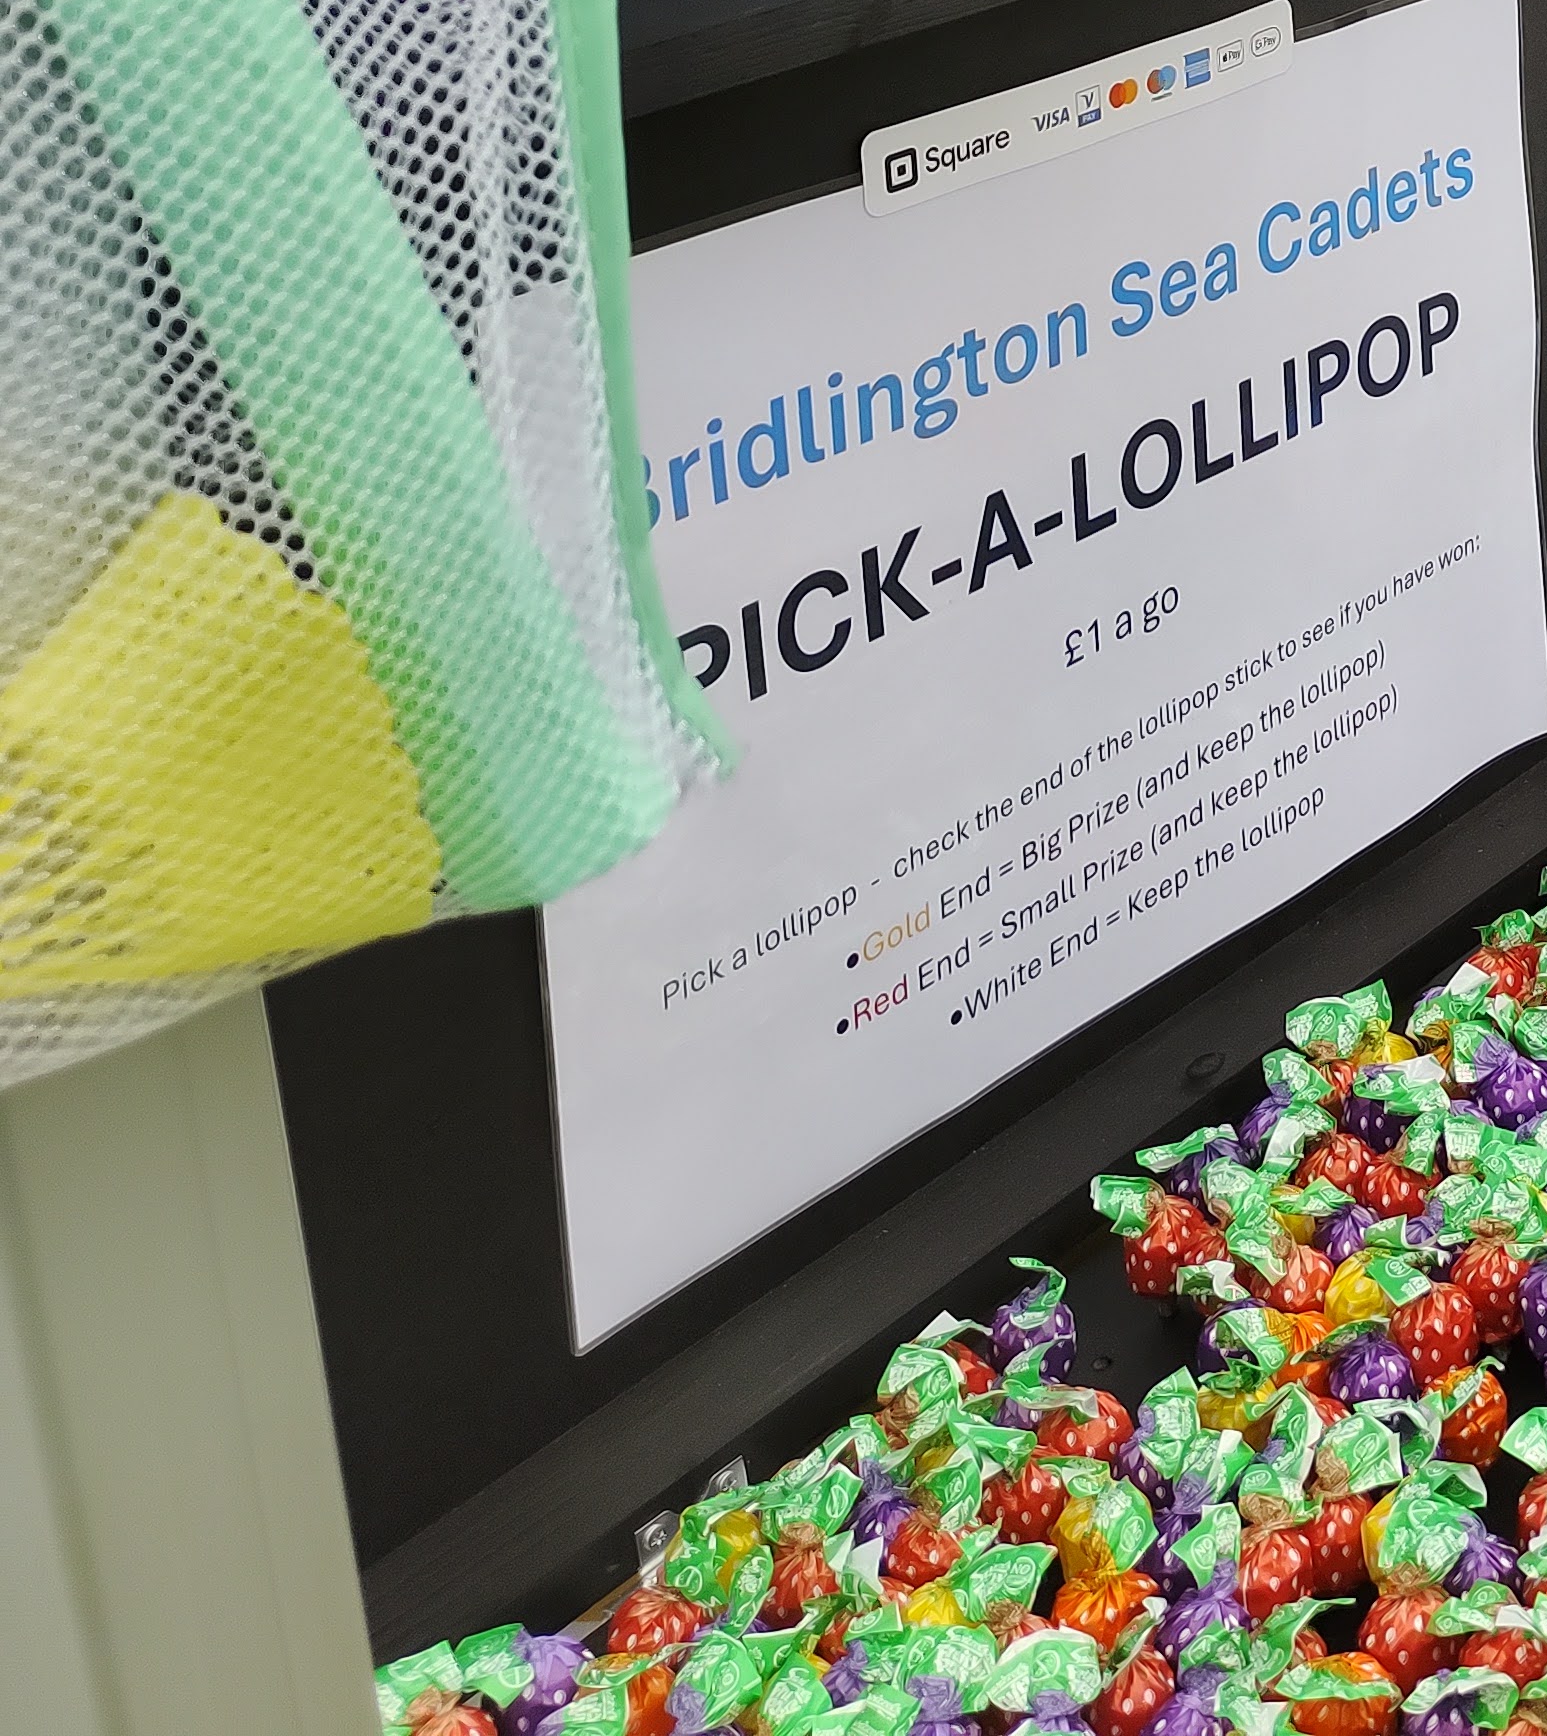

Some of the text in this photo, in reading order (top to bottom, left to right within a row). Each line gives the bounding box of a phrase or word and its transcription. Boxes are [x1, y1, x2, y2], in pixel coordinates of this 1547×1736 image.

[924, 126, 1011, 174] Square
[1031, 106, 1071, 134] VISA
[1108, 242, 1240, 340] Sea
[1256, 140, 1477, 277] Cadets
[676, 292, 1460, 704] PICK-A-LOLLIPOP
[1062, 583, 1181, 671] £1 a go
[662, 957, 726, 1011] Pick
[731, 946, 749, 971] a
[755, 884, 858, 957] lollipop
[893, 818, 970, 878] check
[975, 796, 1015, 833] the
[1020, 762, 1064, 807] end
[1070, 745, 1095, 780] of
[1098, 728, 1134, 764] the
[1138, 681, 1219, 741] lollipop
[1224, 648, 1275, 693] stick
[1276, 638, 1297, 663] to
[1301, 616, 1335, 649] see
[1339, 600, 1351, 628] if
[1353, 584, 1388, 625] you
[1392, 559, 1435, 598] have
[1439, 533, 1481, 571] won:
[852, 682, 1400, 1032] Red End = Small Prize (and keep the lollipop)
[862, 638, 1387, 962] Gold End = Big Prize (and keep the lollipop)
[963, 786, 1325, 1020] White End = Keep the lollipop
